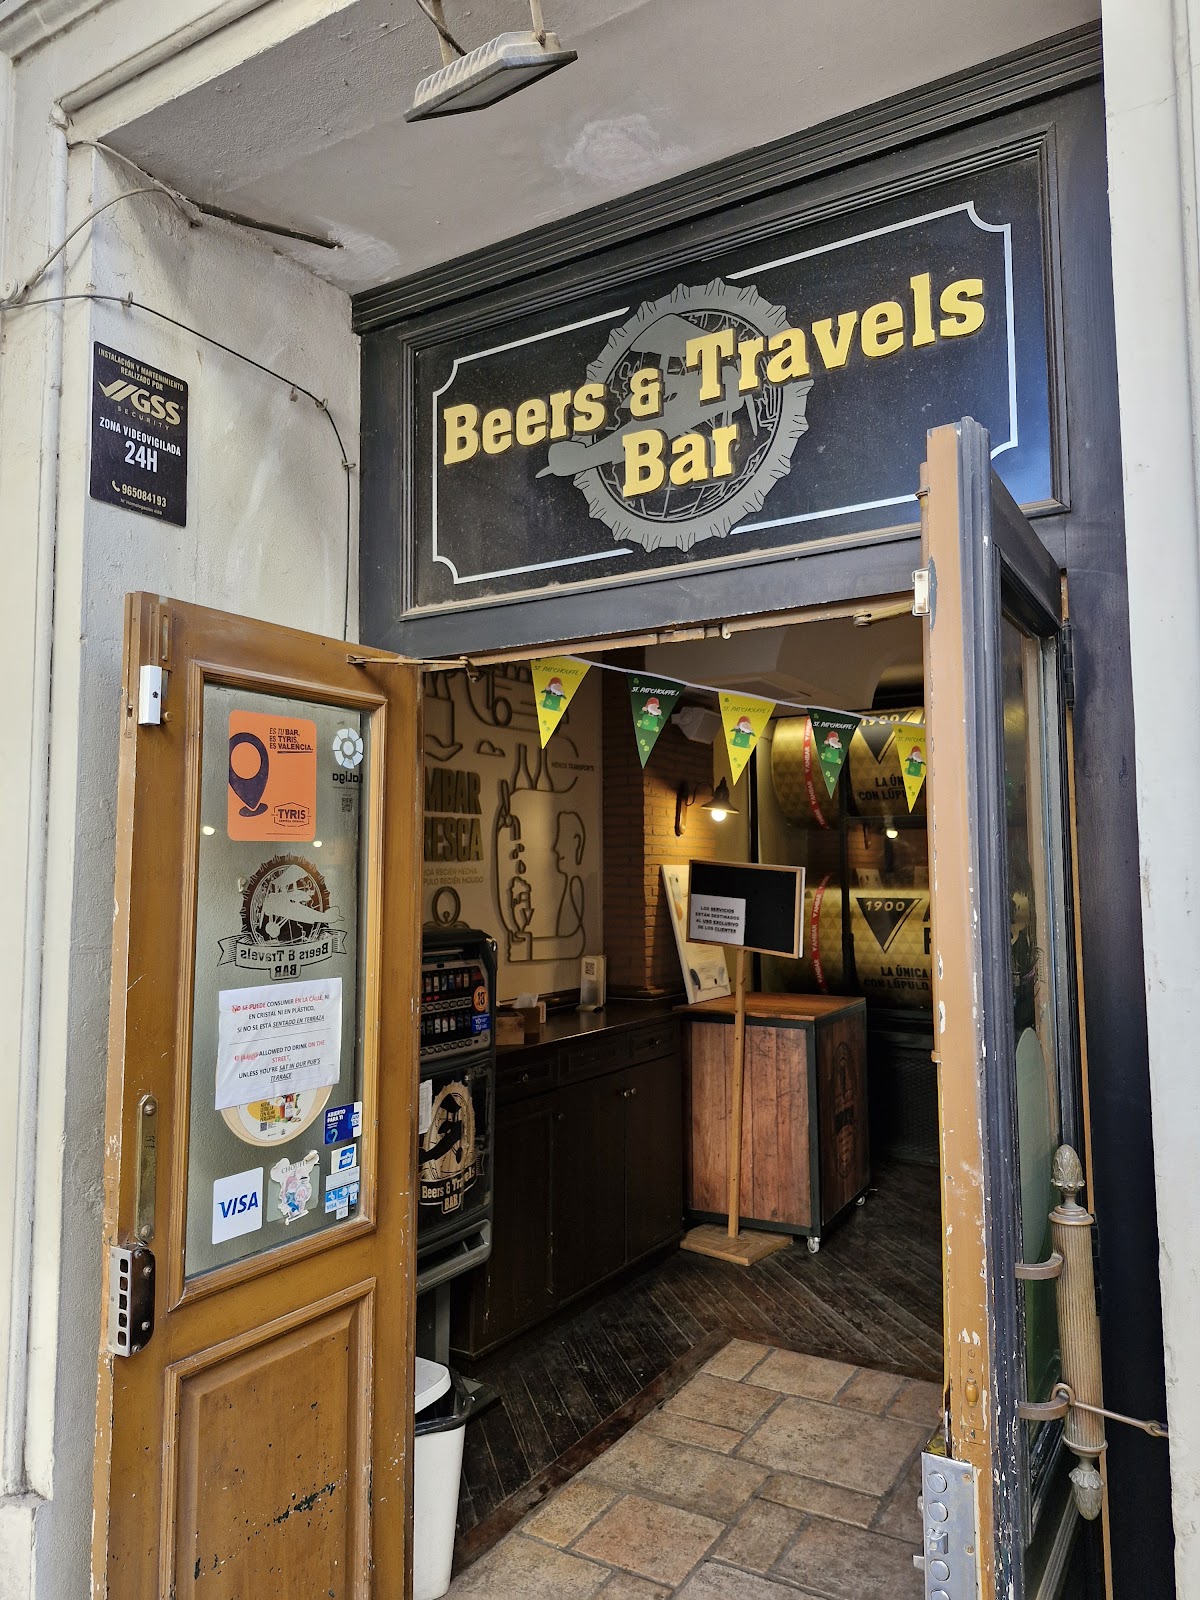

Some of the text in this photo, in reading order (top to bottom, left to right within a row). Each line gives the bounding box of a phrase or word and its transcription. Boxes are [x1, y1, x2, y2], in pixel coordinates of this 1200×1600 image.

[98, 347, 184, 392] INSTALACIÓN Y MANTENIMIENTO
[442, 271, 986, 467] Beers & Travels
[120, 366, 164, 391] REALIZADO POR
[130, 388, 180, 425] GSS
[117, 405, 170, 430] SECURITY
[99, 416, 181, 457] ZONA VIDEOVIGILADA
[124, 440, 158, 473] 24H
[622, 423, 739, 498] Bar
[121, 483, 167, 507] 965084193
[269, 727, 276, 735] ES
[285, 728, 301, 737] BAR,
[277, 742, 314, 751] VALENCIA.
[875, 777, 888, 787] LA
[424, 766, 482, 815] MBAR
[858, 791, 879, 801] CON
[277, 808, 306, 820] TYRIS
[710, 906, 735, 914] SERVICIOS
[866, 900, 905, 911] 1900
[711, 913, 740, 921] DESTINADOS
[714, 926, 736, 934] CLIENTES
[880, 964, 929, 978] LA ÚNICA
[887, 979, 929, 991] LÚPULO
[266, 998, 294, 1008] CONSUMIR
[256, 1011, 277, 1019] CRISTAL
[242, 1025, 252, 1033] NO
[259, 1022, 272, 1030] ESTÁ
[272, 1019, 296, 1028] SENTADO
[304, 1014, 325, 1024] TERRAZA
[258, 1047, 284, 1057] ALLOWED
[292, 1043, 308, 1051] DRINK
[238, 1069, 259, 1079] UNLESS
[259, 1066, 278, 1075] YOU'RE
[278, 1064, 289, 1072] SAT
[296, 1060, 306, 1068] OUR
[306, 1058, 321, 1066] PUB'S
[270, 1072, 292, 1083] TERRACE
[421, 1165, 476, 1199] Beers & Traels
[217, 1191, 258, 1219] VISA
[444, 1193, 458, 1211] BAR
